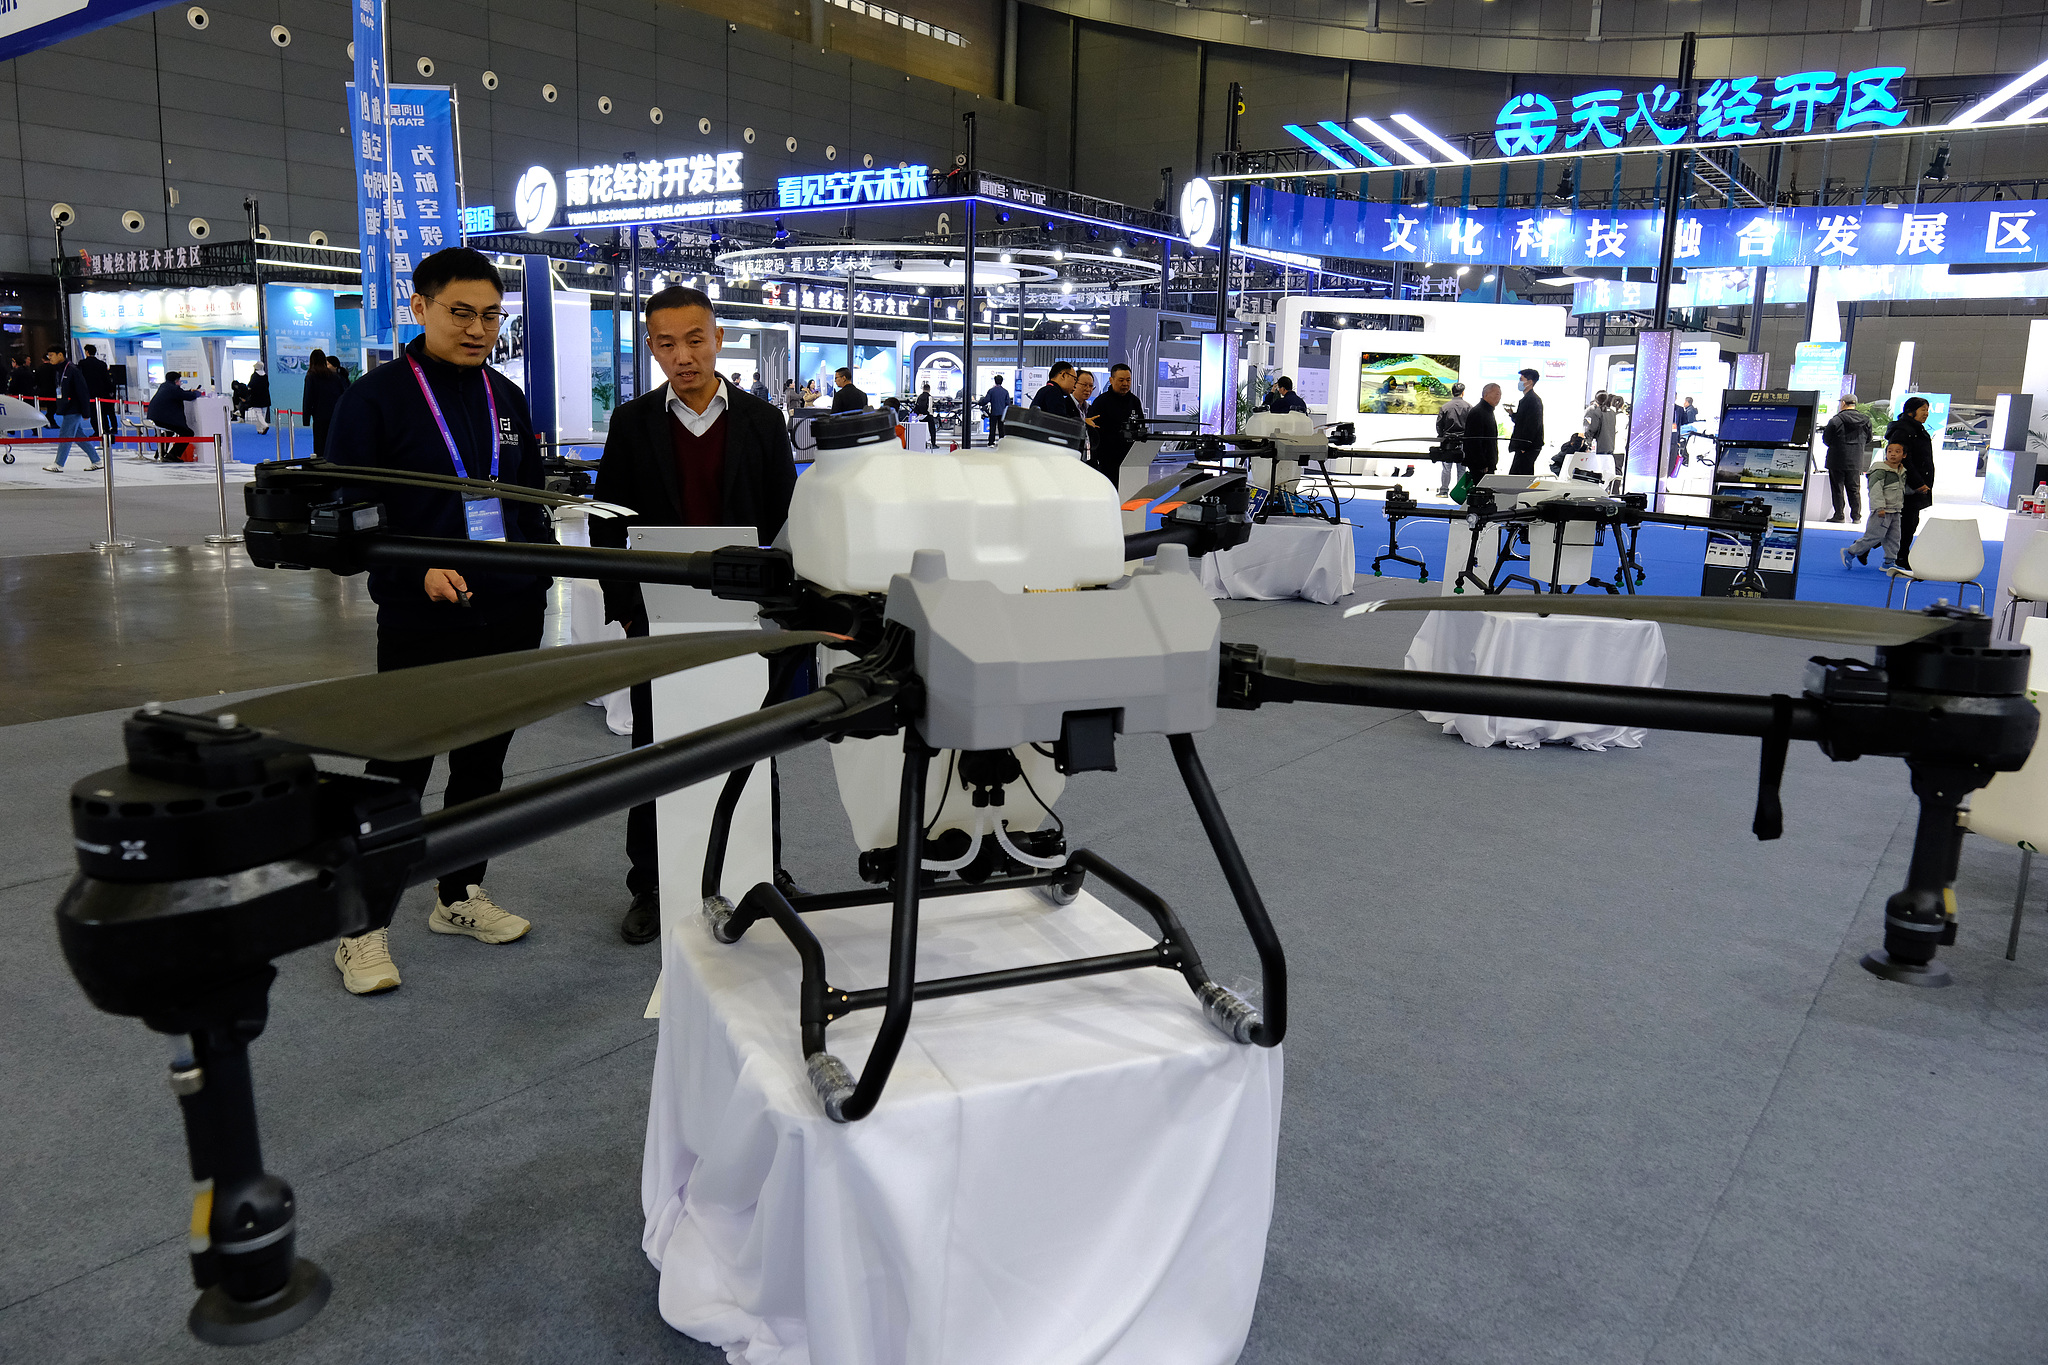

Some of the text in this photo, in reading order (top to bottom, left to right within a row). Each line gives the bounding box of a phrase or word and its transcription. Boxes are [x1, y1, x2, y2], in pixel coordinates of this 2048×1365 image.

[1565, 66, 1907, 149] 天心经开区
[566, 152, 744, 206] 雨花经济开发区
[777, 164, 929, 208] 看见空天未来
[598, 206, 644, 223] ECONOMIC
[645, 201, 714, 219] DEVELOPMENT
[715, 199, 743, 214] ZONE
[937, 212, 950, 243] 6
[1382, 208, 2037, 259] 文化科技融合发展区
[91, 245, 201, 275] 望城经济技术开发区
[791, 255, 873, 272] 看见空天未来
